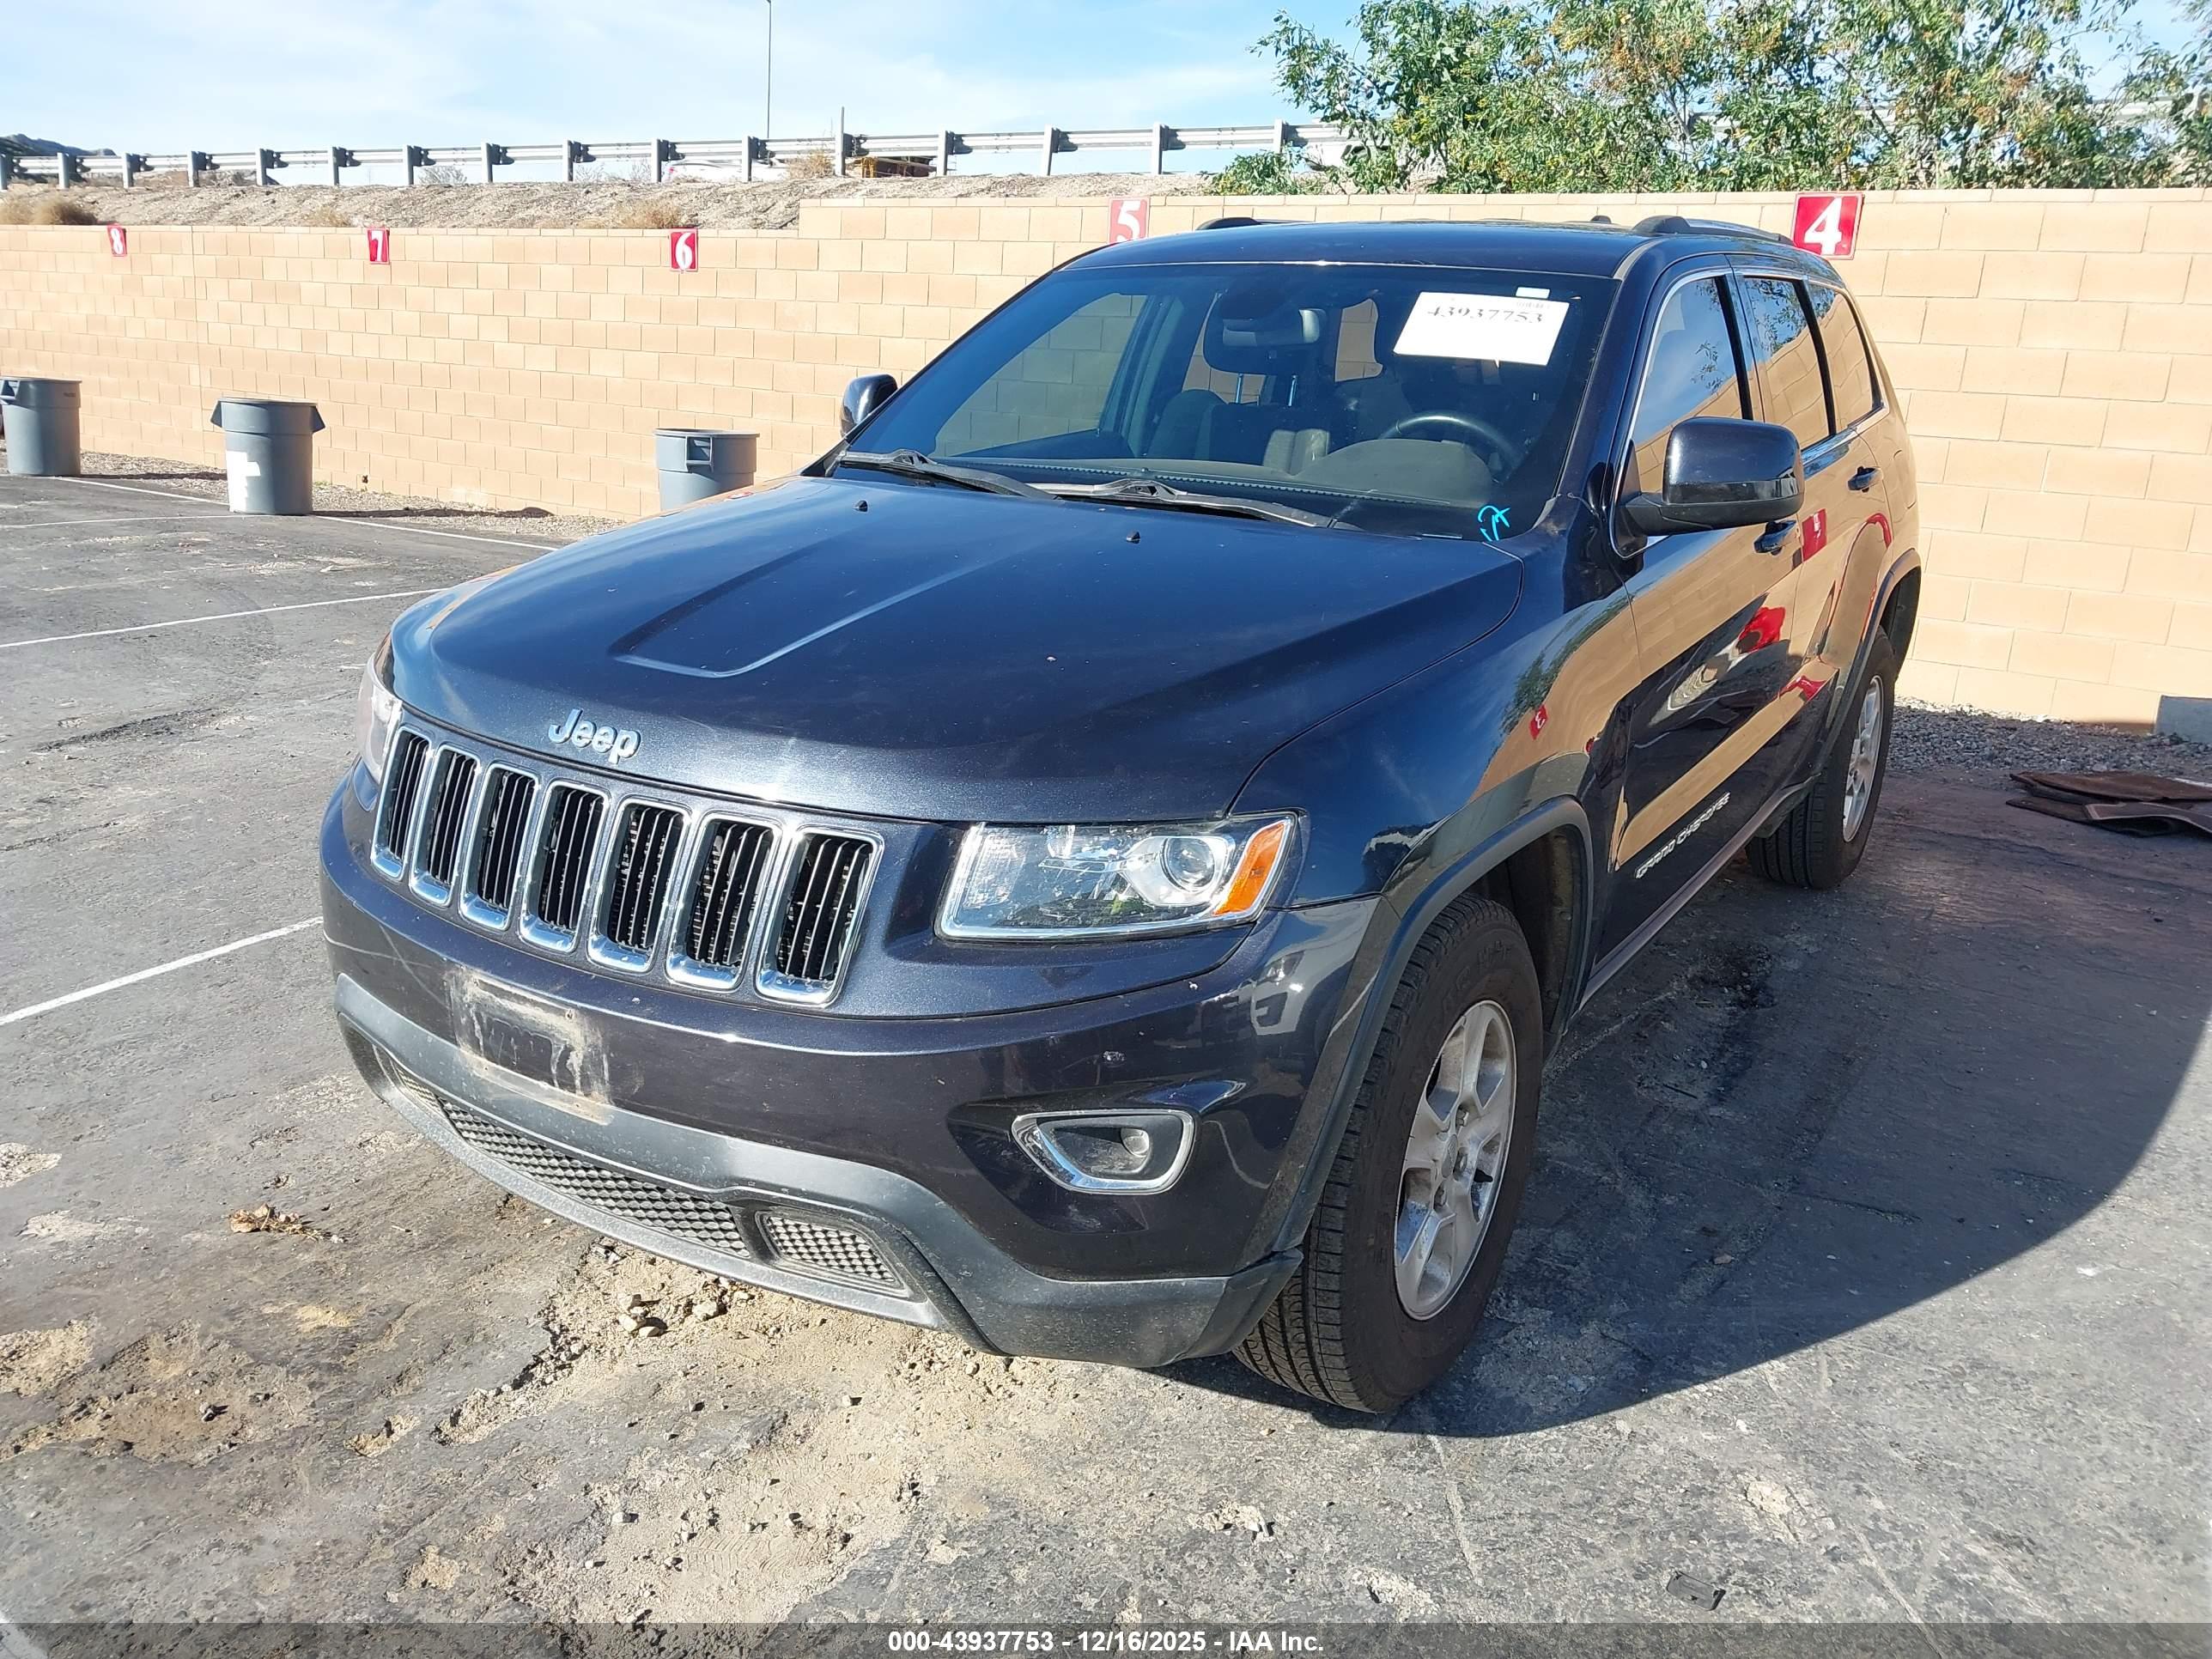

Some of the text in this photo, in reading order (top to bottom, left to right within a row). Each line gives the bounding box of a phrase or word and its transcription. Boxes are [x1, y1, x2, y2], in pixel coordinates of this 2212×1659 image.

[1115, 199, 1141, 242] 5
[1803, 197, 1843, 255] 4
[110, 228, 124, 255] 8
[370, 229, 384, 261] 7
[674, 232, 693, 270] 6
[1426, 305, 1544, 323] 43937753
[548, 708, 641, 765] Jeep
